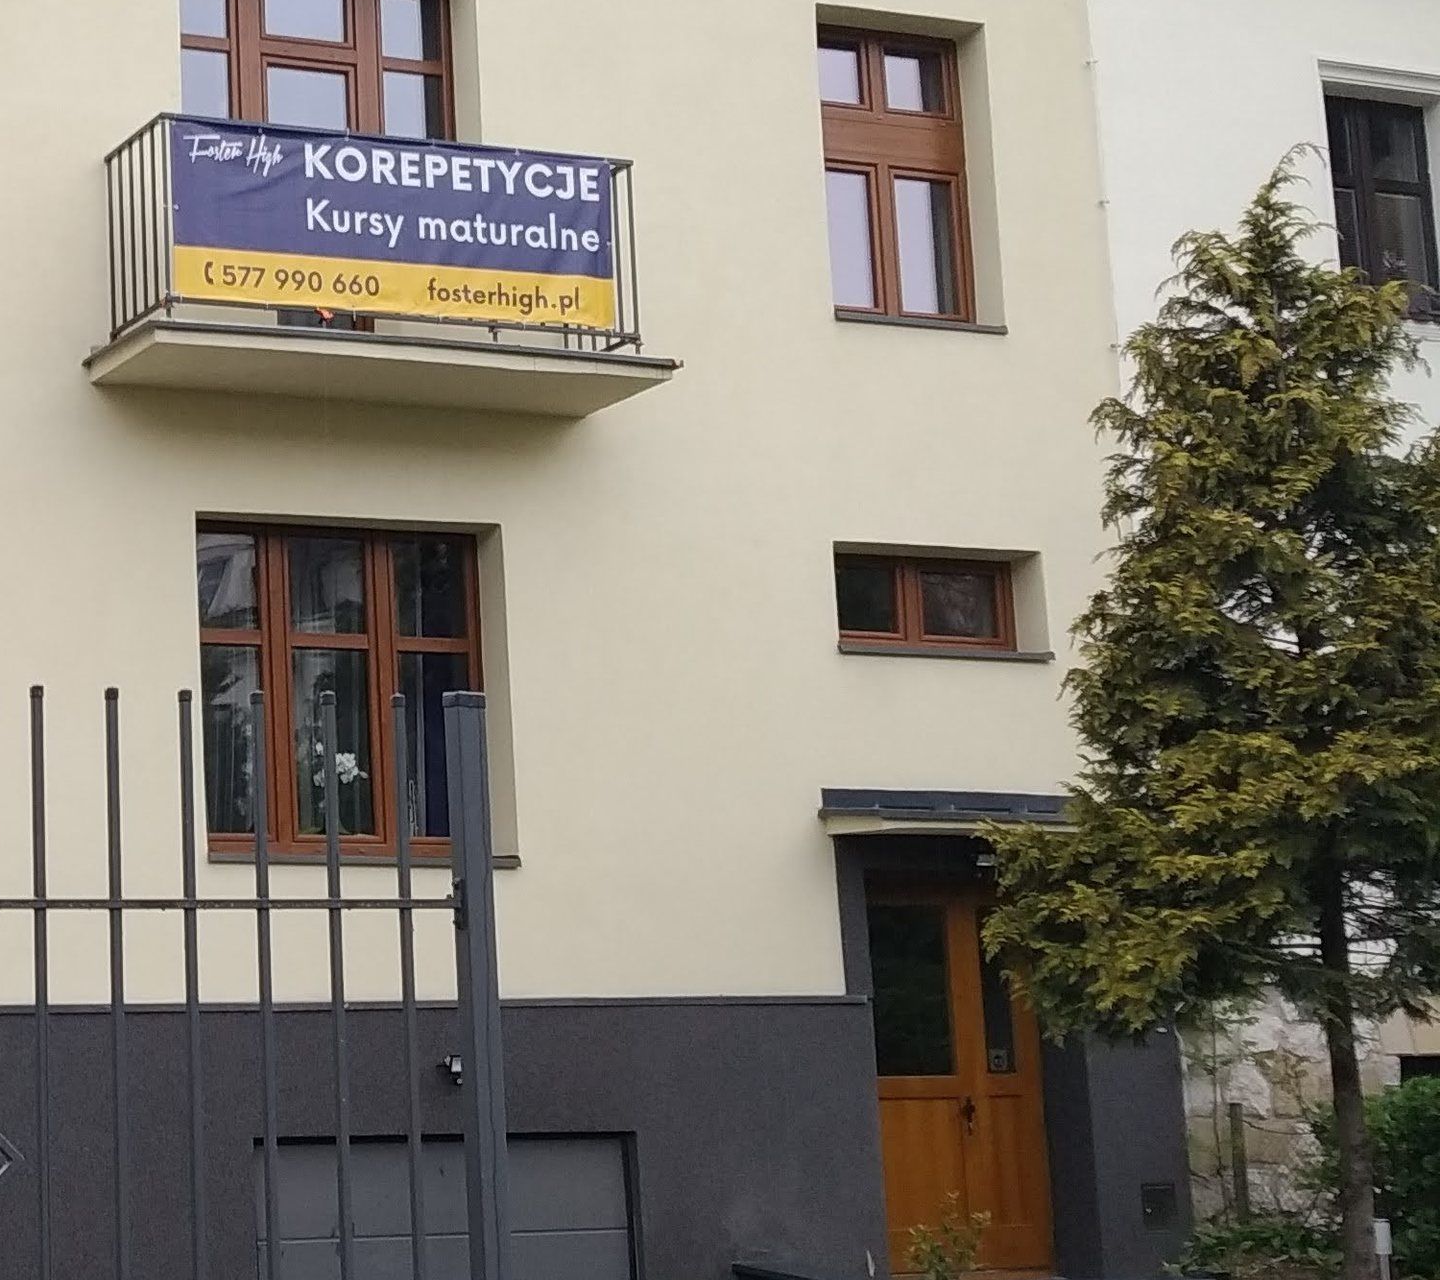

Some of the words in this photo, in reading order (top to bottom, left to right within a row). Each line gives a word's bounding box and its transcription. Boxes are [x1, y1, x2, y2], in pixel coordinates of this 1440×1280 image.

[246, 134, 283, 177] High
[304, 142, 600, 202] KOREPETYCJE
[306, 198, 404, 248] Kursy
[418, 212, 600, 252] maturalne
[222, 264, 266, 288] 577
[274, 268, 323, 293] 990
[332, 273, 380, 297] 660
[427, 277, 580, 316] fosterhigh.pl
